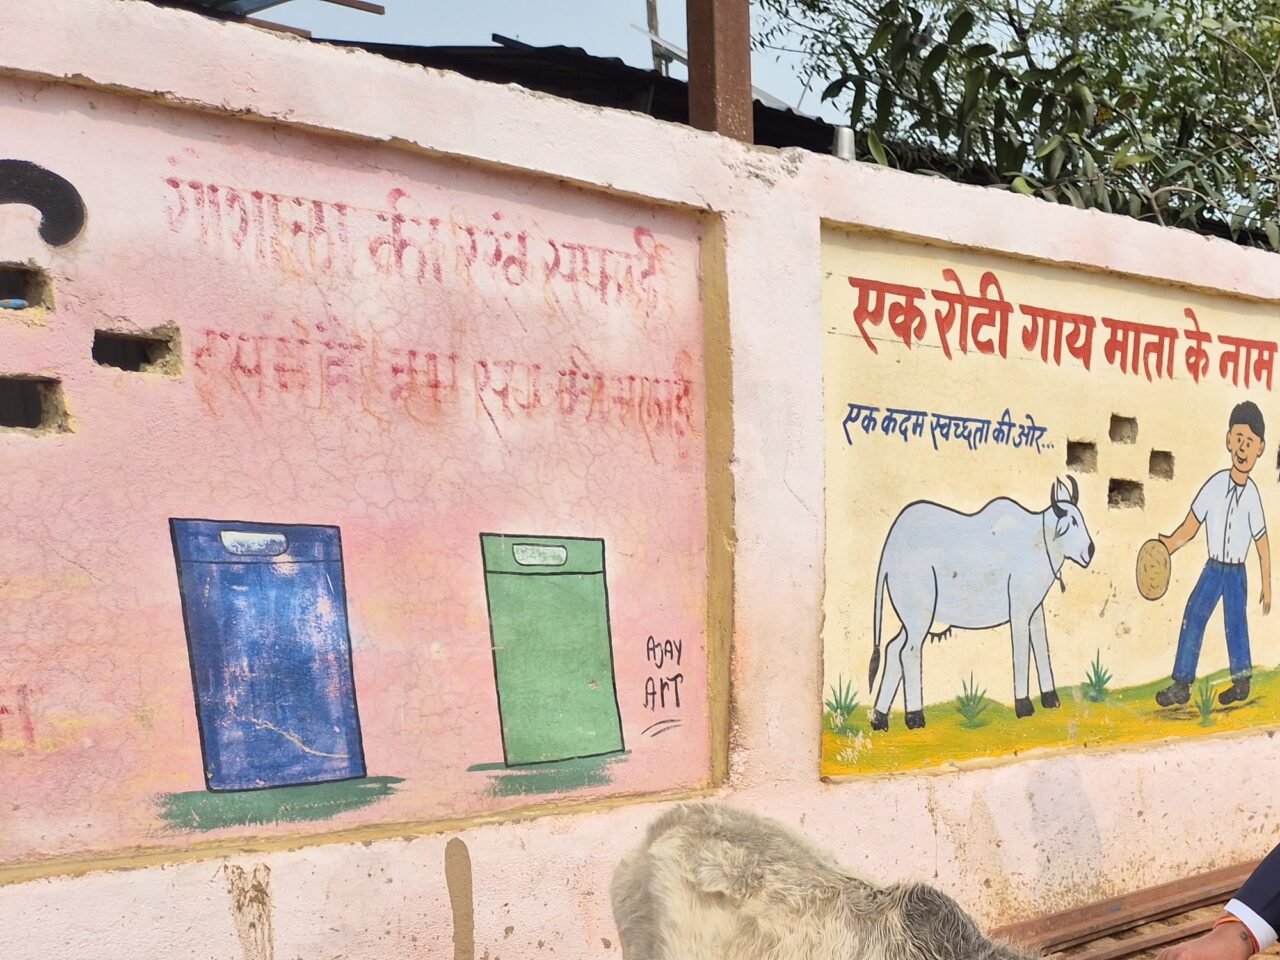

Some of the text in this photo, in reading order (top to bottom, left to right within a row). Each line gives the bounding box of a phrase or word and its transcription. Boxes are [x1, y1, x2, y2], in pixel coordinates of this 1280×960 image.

[848, 268, 1278, 392] एक रोटी गाय माता के नाम
[842, 403, 880, 445] एक
[881, 408, 928, 442] कदम
[930, 413, 991, 450] स्वच्छता
[992, 408, 1016, 445] की
